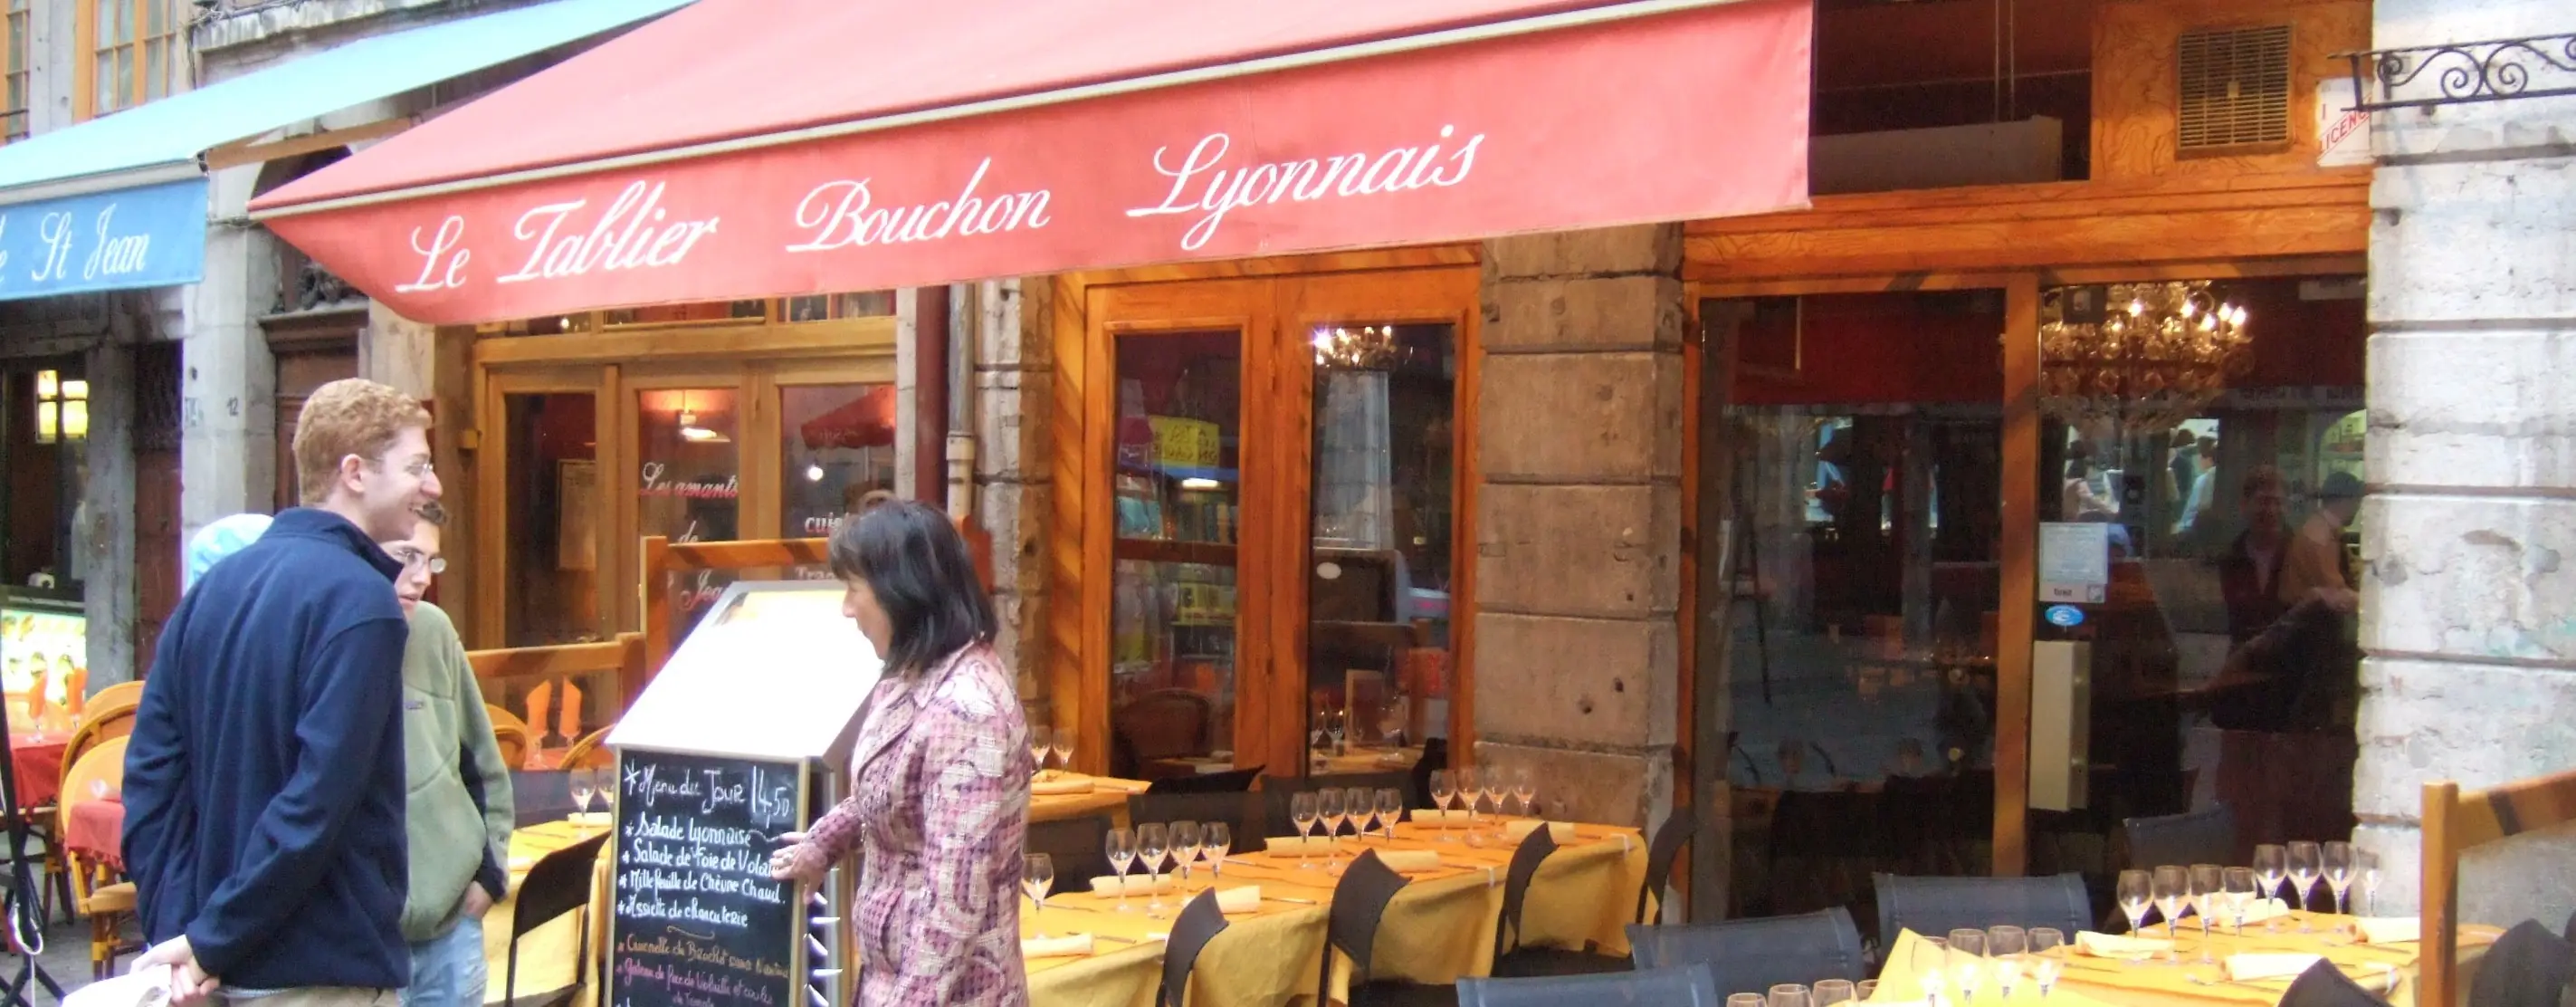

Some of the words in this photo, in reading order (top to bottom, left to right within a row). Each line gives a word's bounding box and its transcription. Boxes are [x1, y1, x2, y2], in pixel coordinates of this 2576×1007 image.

[394, 214, 470, 293] Le
[496, 179, 719, 283] Tablier
[786, 156, 1052, 252] Bouchon
[1126, 124, 1485, 251] Lyonnais
[32, 211, 72, 281] St
[83, 203, 149, 281] Jean
[639, 462, 671, 496] Les
[673, 475, 739, 498] amants
[680, 569, 723, 611] Jea
[638, 763, 677, 807] Menu
[680, 768, 701, 795] du
[634, 811, 684, 841] Salade
[634, 838, 673, 867] Salade
[676, 847, 692, 867] de
[720, 850, 736, 871] de
[682, 870, 697, 891] de
[668, 898, 682, 919] de
